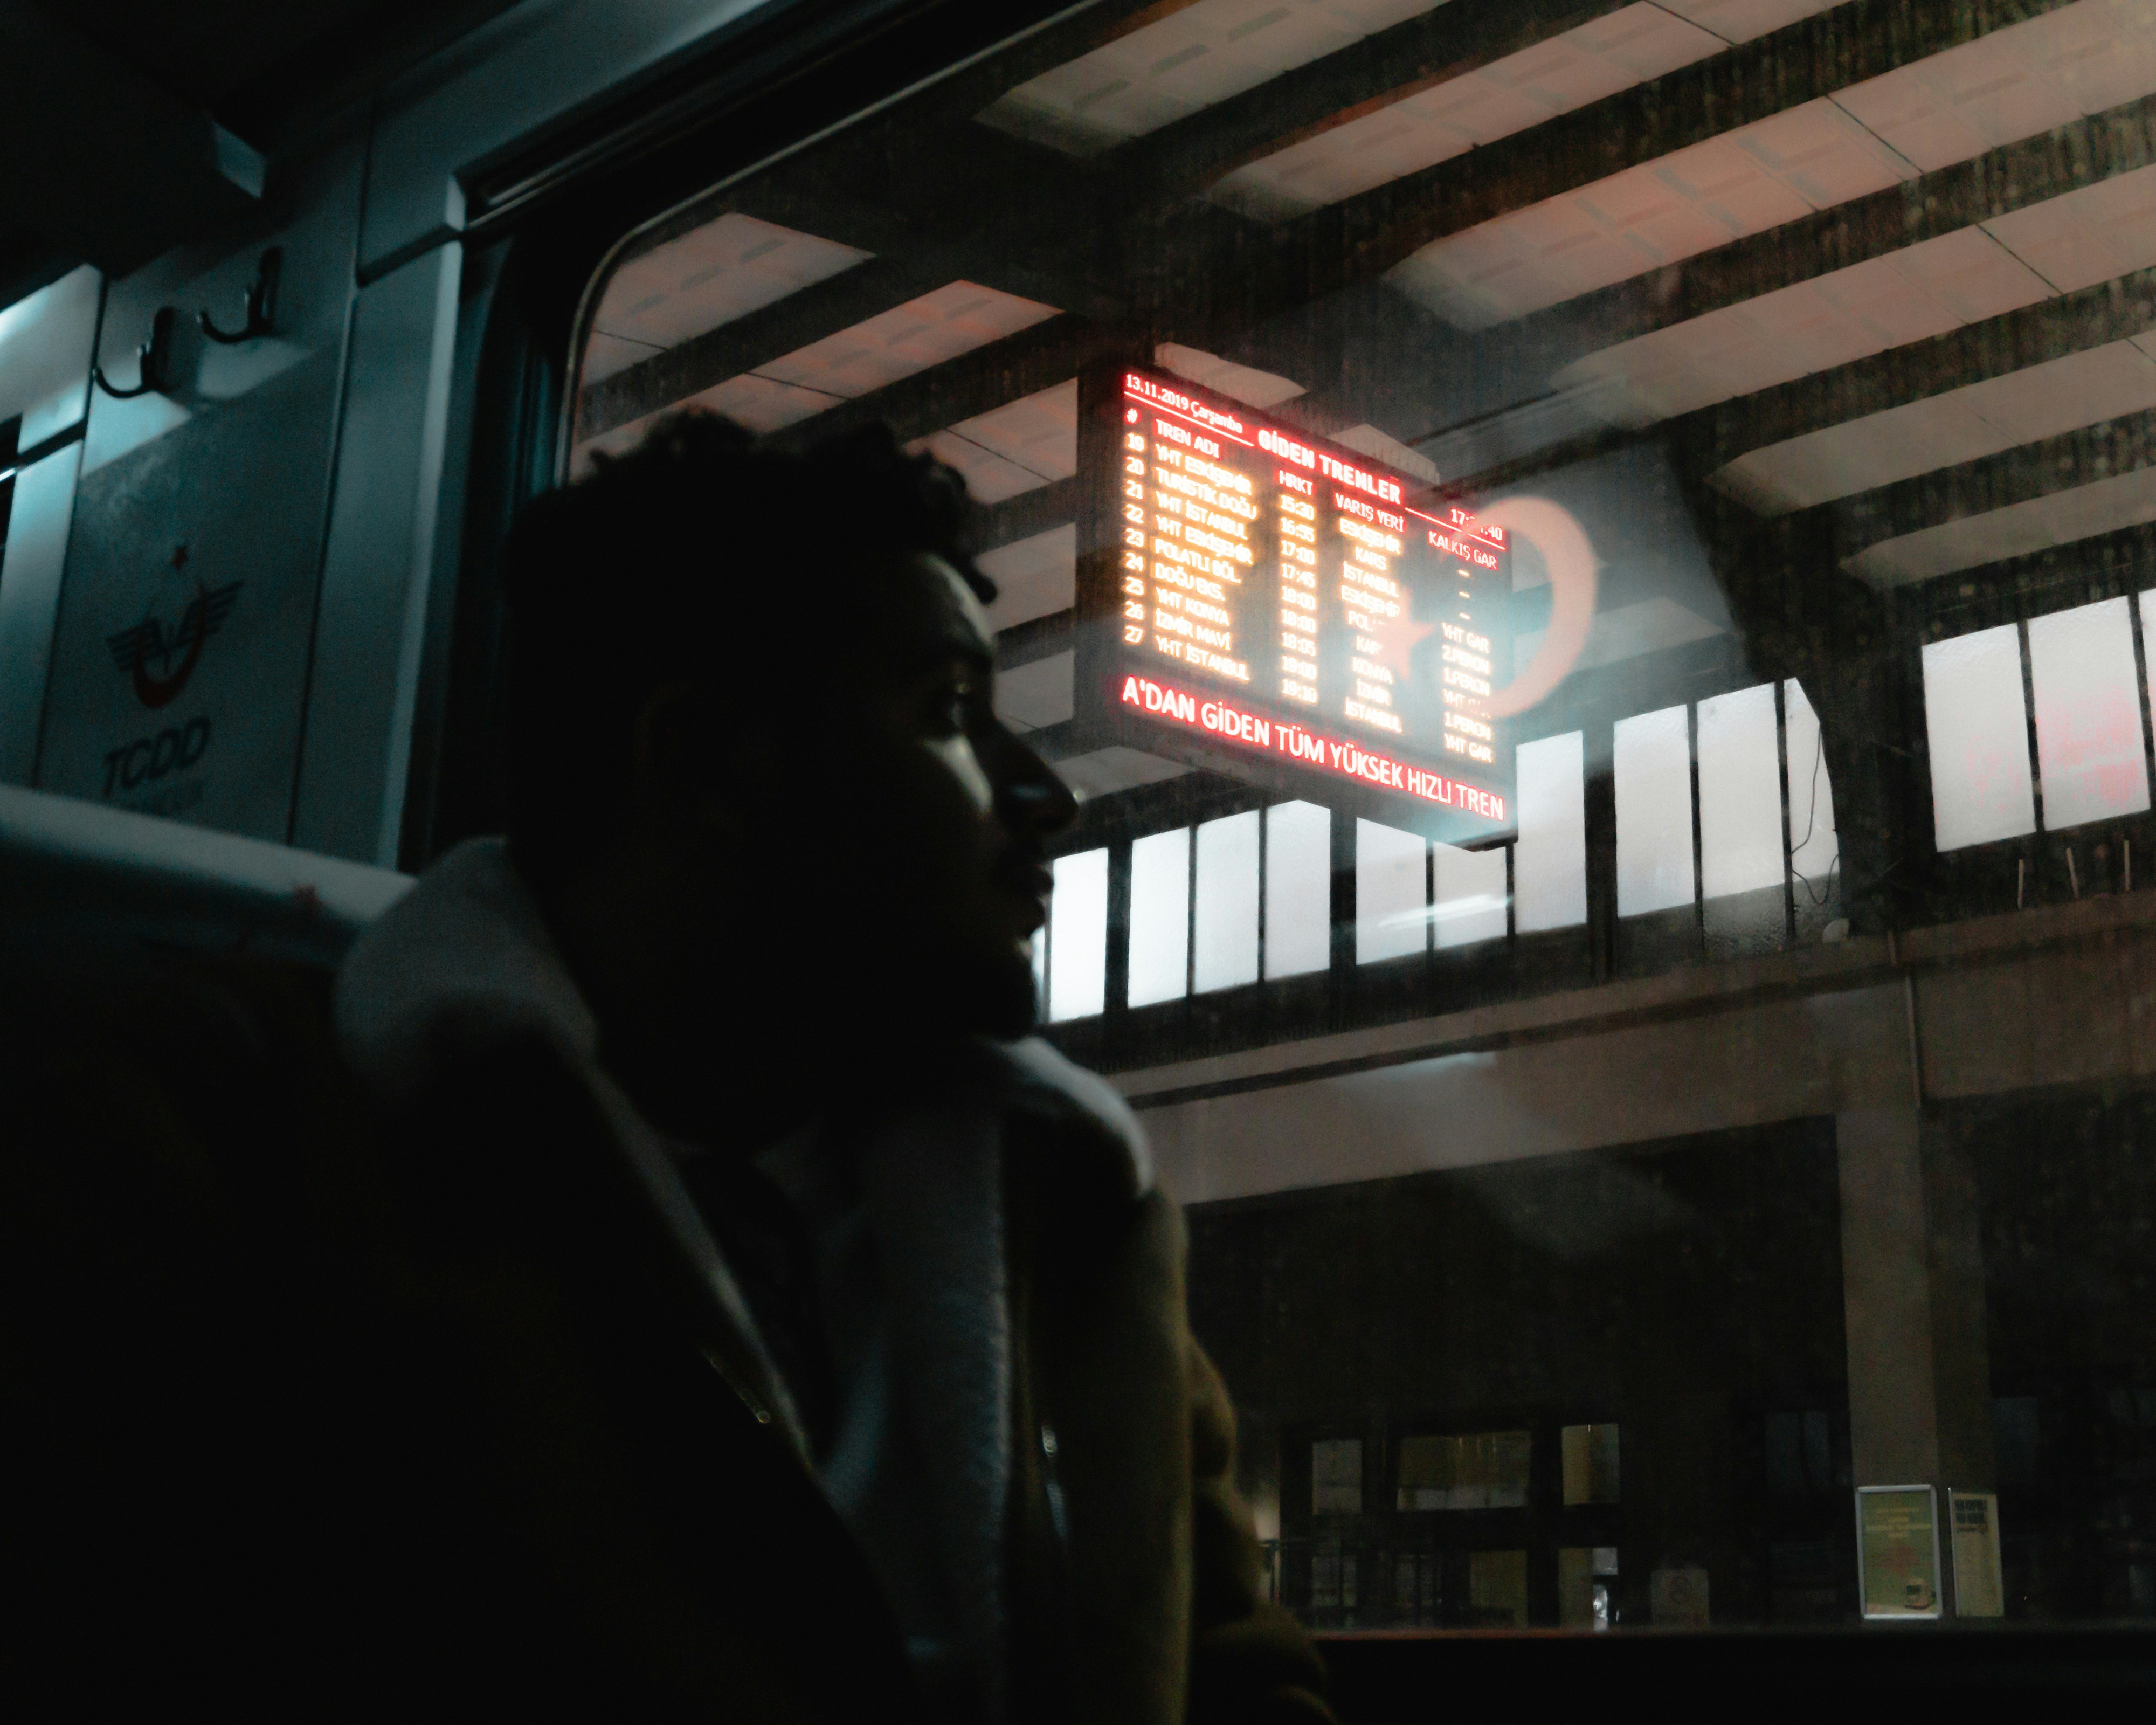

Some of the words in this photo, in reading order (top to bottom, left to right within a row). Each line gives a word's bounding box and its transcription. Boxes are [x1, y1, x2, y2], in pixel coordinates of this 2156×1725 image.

[1127, 374, 1189, 410] 13.11.2019
[1190, 401, 1242, 433] Çarşamba
[1128, 433, 1144, 452] 19
[1156, 419, 1191, 446] TREN
[1194, 436, 1219, 458] ADI
[1127, 457, 1144, 475] 20
[1156, 444, 1182, 466] YHT
[1258, 430, 1315, 469] GİDEN
[1319, 454, 1400, 505] TRENLER
[1126, 480, 1143, 500] 21
[1156, 467, 1217, 505] TURİSTİK
[1219, 493, 1256, 519] DOĞU
[1279, 470, 1313, 495] HRKT
[1126, 504, 1143, 523] 22
[1156, 491, 1182, 513] YHT
[1186, 500, 1247, 540] İSTANBUL
[1281, 495, 1314, 520] 15:30
[1335, 493, 1374, 522] VARIŞ
[1377, 509, 1404, 533] YERİ
[1126, 528, 1144, 547] 23
[1156, 515, 1182, 537] YHT
[1451, 509, 1502, 541] 17::40
[1126, 553, 1143, 571] 24
[1155, 539, 1210, 572] POLATLI
[1282, 540, 1315, 565] 17:00
[1355, 546, 1387, 570] KARS
[1429, 531, 1470, 561] KALKIŞ
[1474, 549, 1496, 570] GAR
[1126, 576, 1144, 596] 25
[1155, 563, 1194, 589] DOĞU
[1282, 563, 1315, 588] 17:45
[1344, 562, 1399, 598] İSTANBUL
[1125, 601, 1143, 620] 26
[1156, 587, 1183, 609] YHT
[1185, 598, 1229, 626] KONYA
[1125, 625, 1143, 643] 27
[1156, 608, 1193, 637] İZMİR
[1196, 625, 1230, 650] MAVİ
[1442, 623, 1464, 643] YHT
[1466, 633, 1489, 653] GAR
[1156, 635, 1183, 657] YHT
[1186, 643, 1249, 680] İSTANBUL
[1356, 636, 1383, 656] KAR
[1442, 645, 1490, 674] 2.PERON
[1353, 657, 1392, 684] KONYA
[1443, 667, 1489, 696] 1.PERON
[1357, 679, 1391, 706] İZMİR
[1345, 697, 1402, 732] İSTANBUL
[1445, 712, 1490, 740] 1.PERON
[103, 716, 211, 798] TCDD
[1123, 677, 1195, 722] A'DAN
[1201, 701, 1269, 746] GİDEN
[1275, 725, 1324, 763] TÜM
[1329, 742, 1404, 789] YÜKSEK
[1408, 768, 1452, 804] HIZLI
[1457, 784, 1503, 820] TREN
[1444, 733, 1467, 751] YHT
[1469, 742, 1491, 762] GAR
